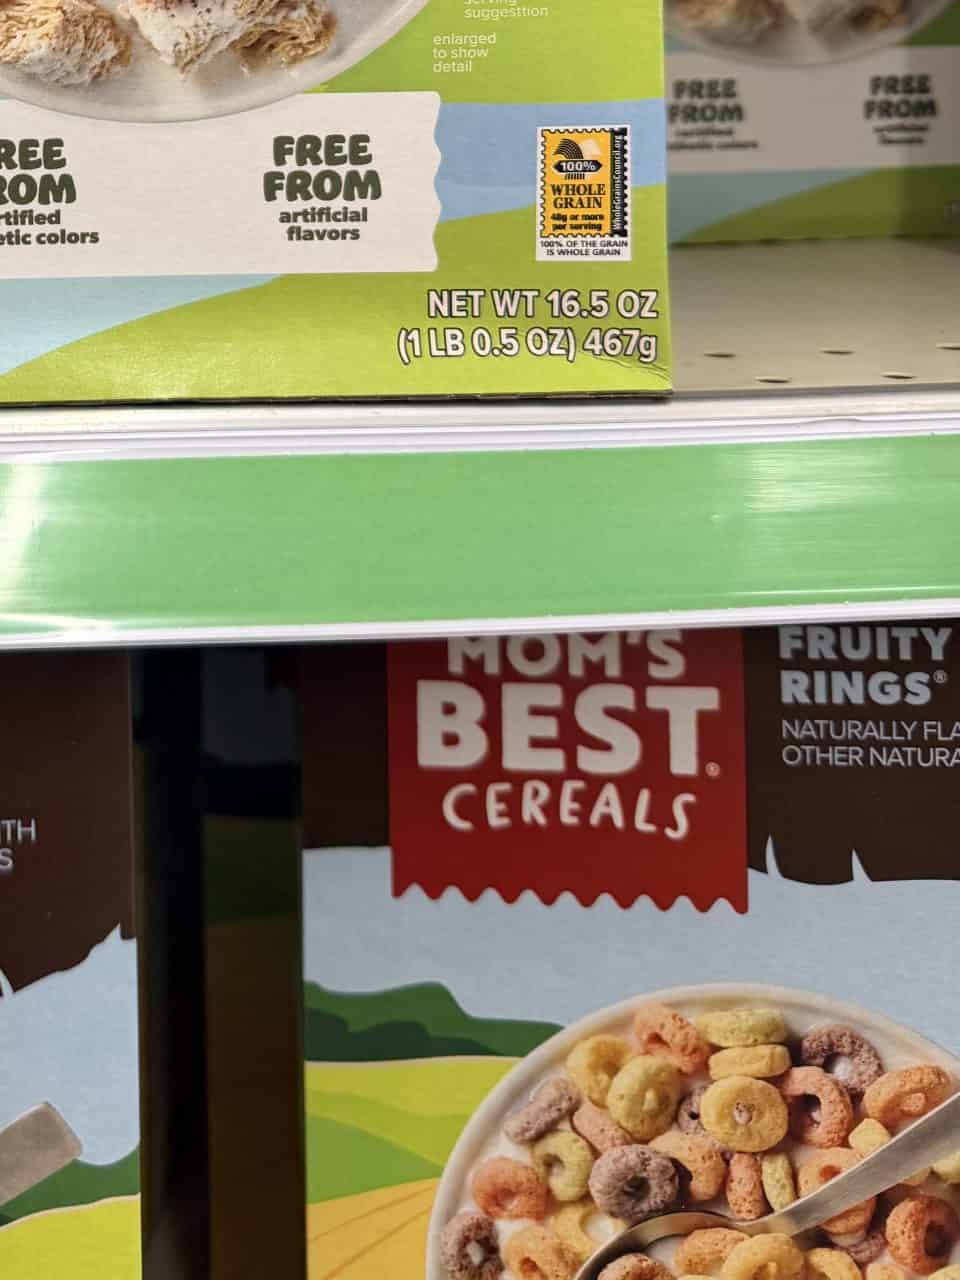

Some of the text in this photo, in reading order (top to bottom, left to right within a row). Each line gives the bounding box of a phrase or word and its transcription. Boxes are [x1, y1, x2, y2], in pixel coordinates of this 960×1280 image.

[432, 32, 496, 47] enlarged
[432, 47, 488, 58] to show
[432, 60, 472, 73] detail
[273, 133, 372, 166] FREE
[560, 161, 596, 171] 100%
[263, 169, 381, 202] FROM
[550, 183, 606, 196] WHOLE
[553, 196, 602, 209] GRAIN
[279, 206, 368, 224] artificial
[36, 228, 100, 245] colors
[287, 225, 360, 241] flavors
[540, 240, 563, 248] 100%
[566, 240, 578, 248] OF
[581, 240, 597, 248] THE
[546, 248, 621, 256] IS WHOLE GRAIN
[428, 290, 659, 318] NET WT 16.5 OZ
[397, 328, 657, 364] (1 LB 0.5 OZ) 467g
[779, 624, 952, 660] FRUITY
[782, 719, 917, 740] NATURALLY
[782, 745, 864, 765] OTHER
[442, 780, 696, 840] CEREALS
